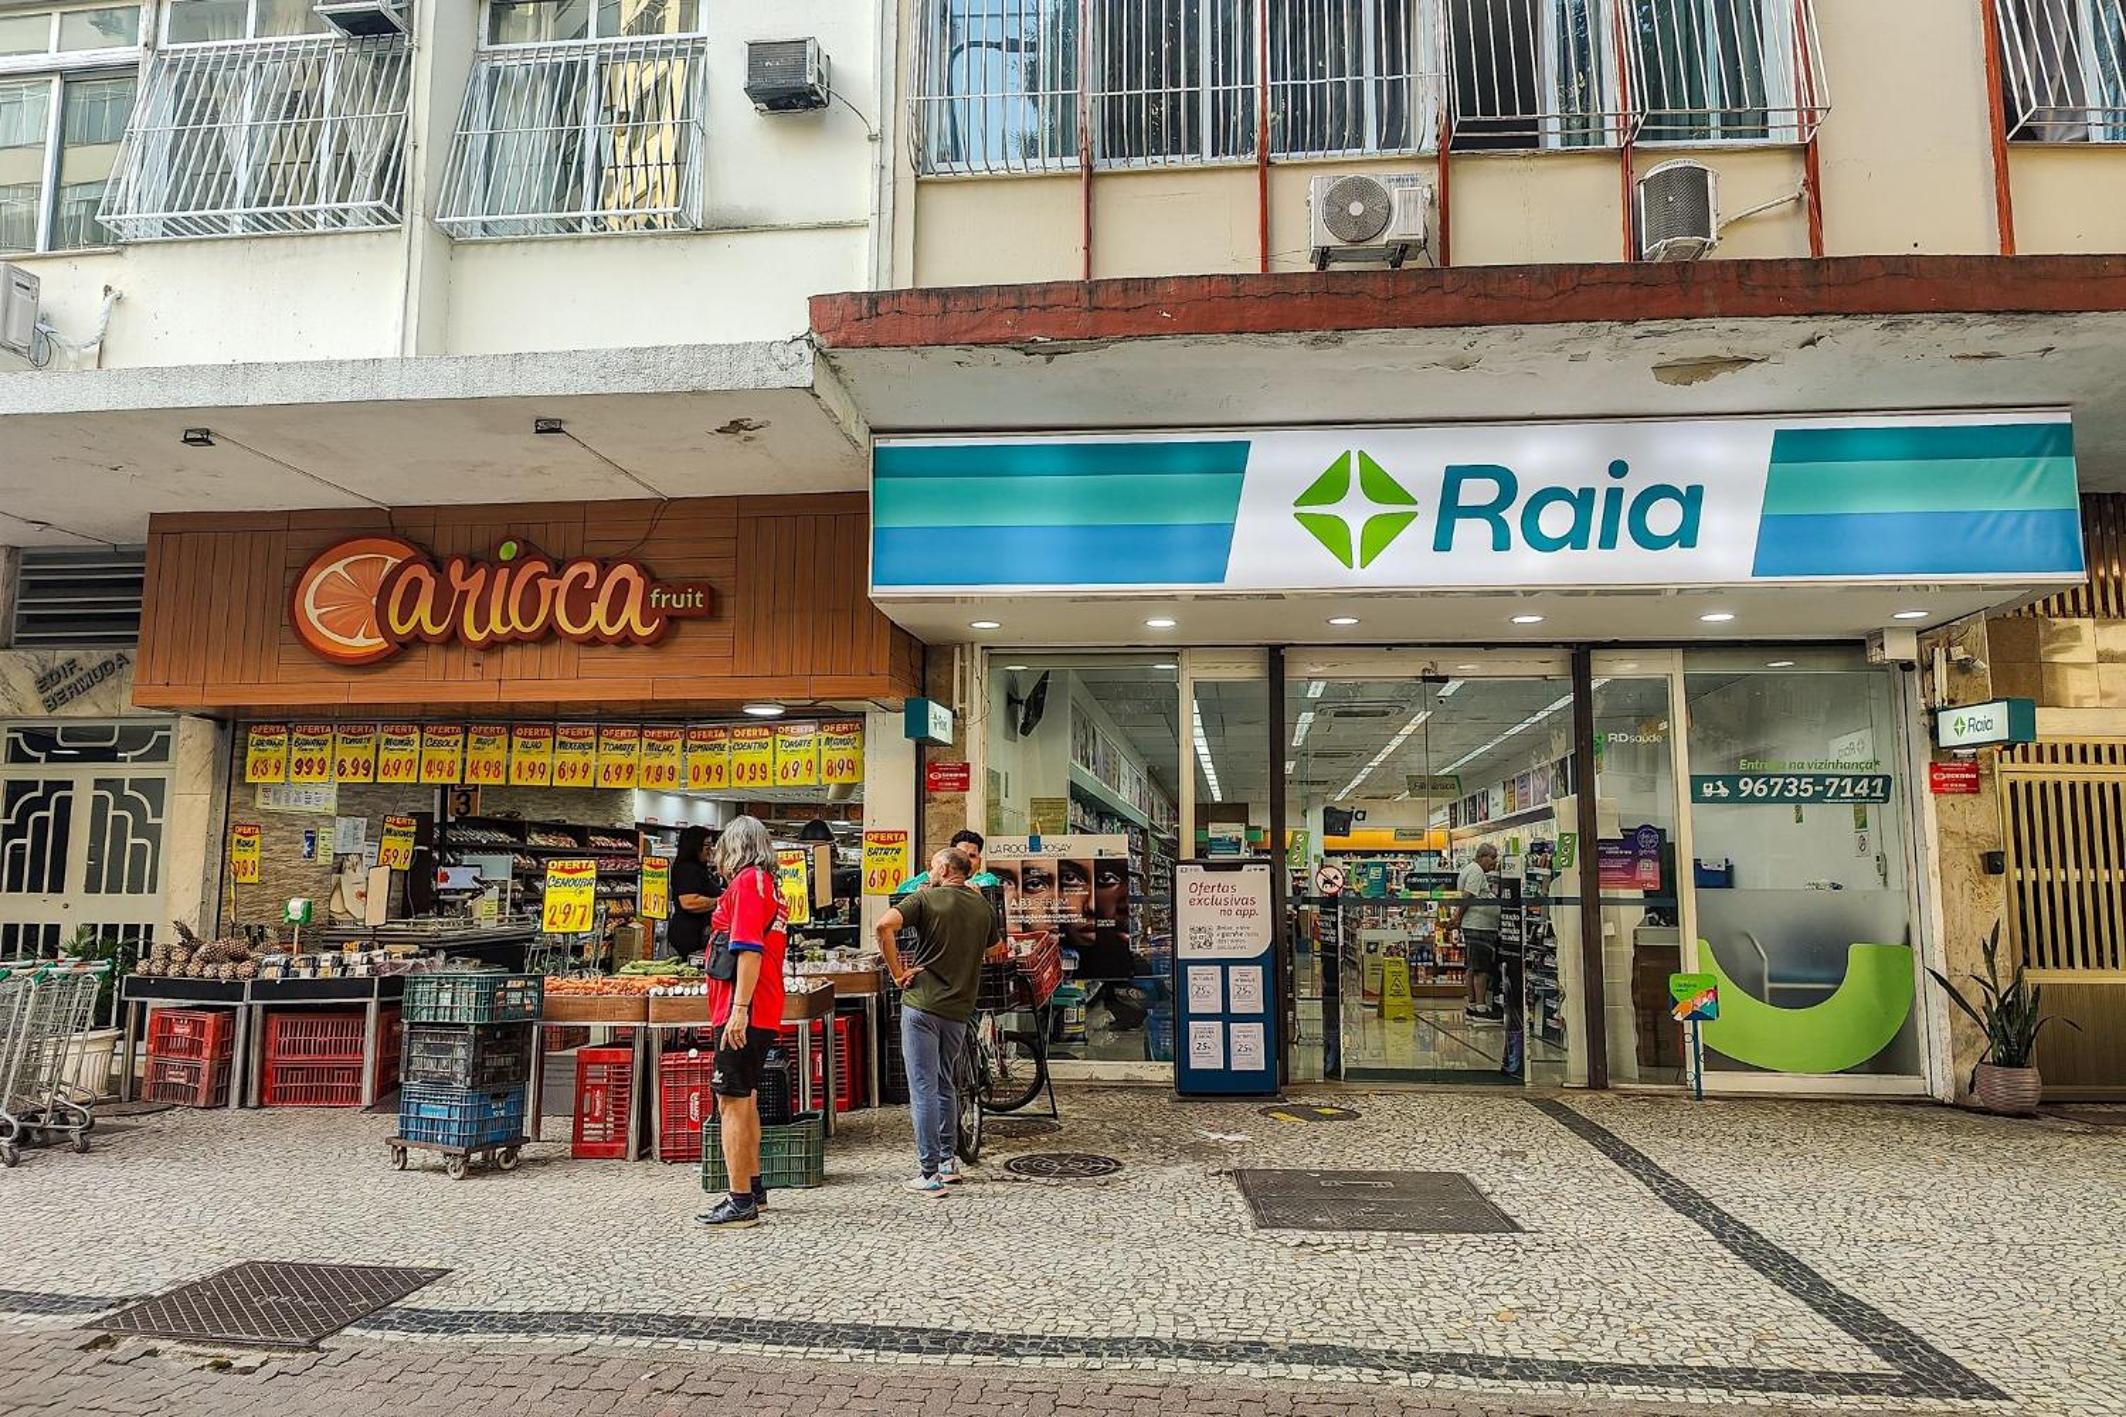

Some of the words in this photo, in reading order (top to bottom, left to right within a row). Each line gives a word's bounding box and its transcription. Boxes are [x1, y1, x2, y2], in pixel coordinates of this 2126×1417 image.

[1433, 459, 1704, 552] Raia
[295, 537, 660, 656] Carioca
[650, 588, 704, 609] fruit
[35, 658, 84, 695] EDIF.
[42, 652, 131, 713] BERMUDA
[251, 725, 287, 734] OFERTA
[295, 725, 331, 734] OFERTA
[340, 725, 375, 734] OFERTA
[383, 725, 419, 734] OFERTA
[426, 725, 462, 734] OFERTA
[471, 726, 507, 734] OFERTA
[516, 727, 551, 737] OFERTA
[558, 727, 594, 737] OFERTA
[777, 725, 815, 735] OFERTA
[823, 722, 862, 732] OFERTA
[602, 729, 638, 738] OFERTA
[644, 729, 680, 739] OFERTA
[689, 729, 725, 740] OFERTA
[733, 727, 769, 738] OFERTA
[603, 742, 636, 752] TOMATE
[1789, 762, 1805, 770] na
[1738, 777, 1884, 798] 96735-7141
[455, 793, 471, 816] 3
[383, 815, 417, 825] OFERTA
[866, 833, 908, 841] OFERTA
[547, 860, 596, 870] OFERTA
[1189, 882, 1237, 896] Ofertas
[1188, 894, 1257, 907] exclusivas
[1220, 908, 1233, 916] no
[1235, 908, 1259, 919] app.
